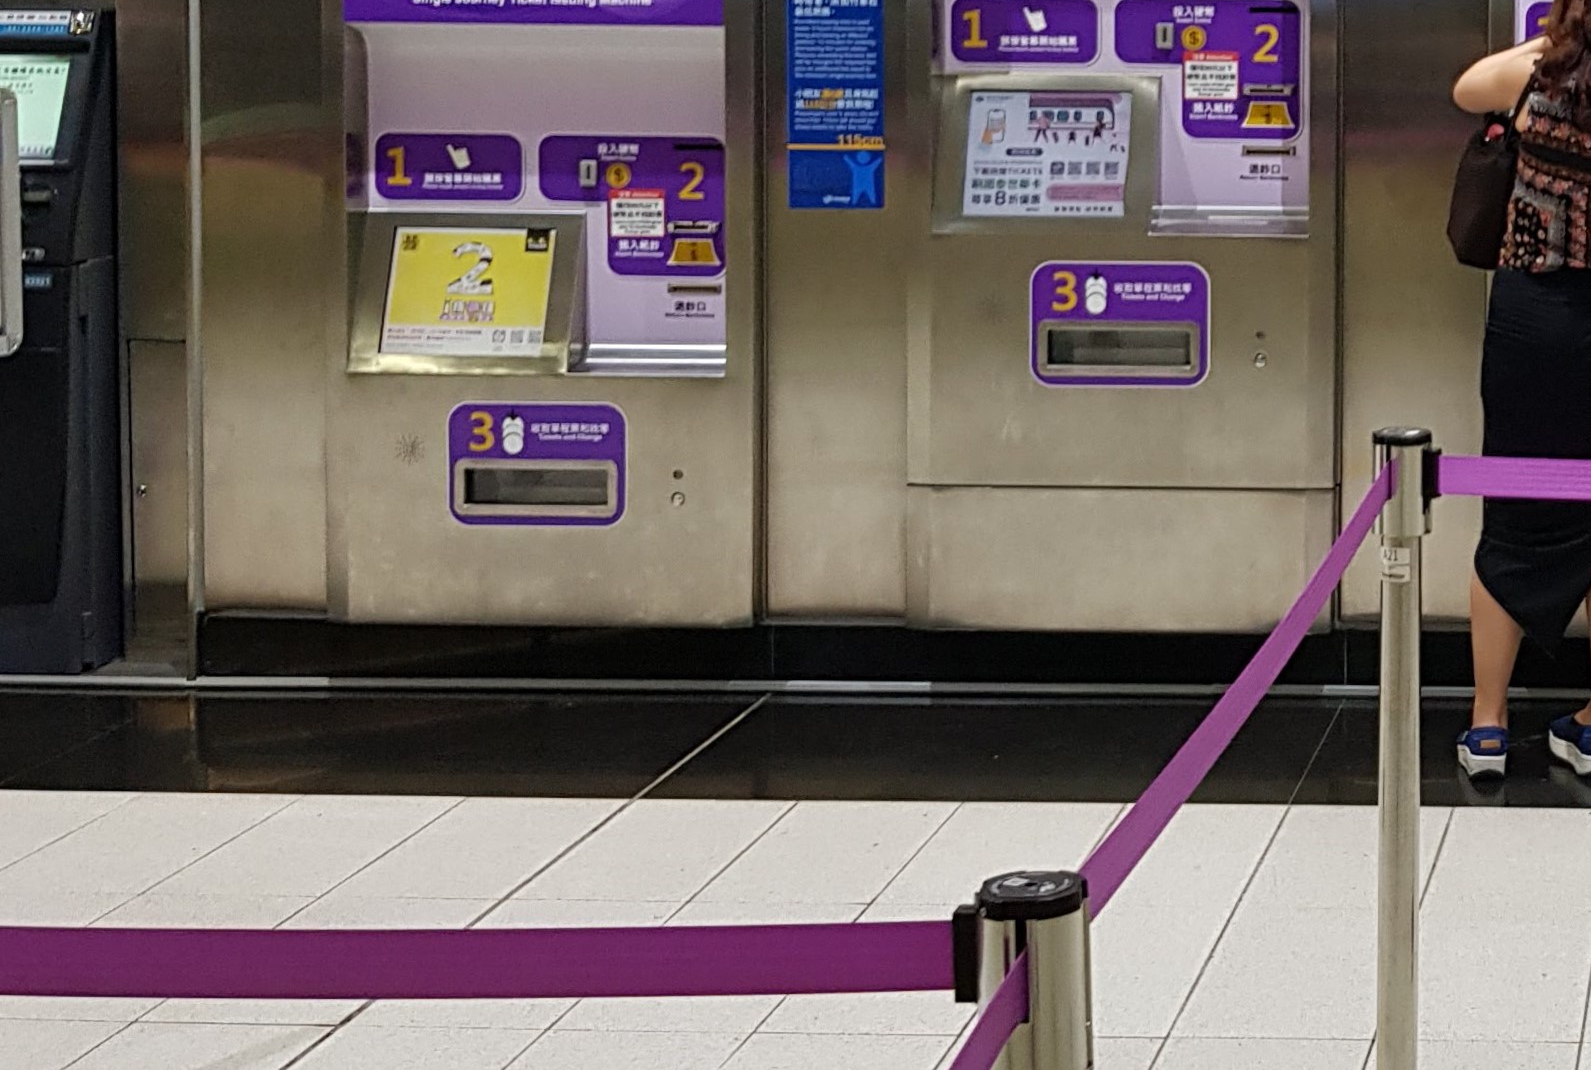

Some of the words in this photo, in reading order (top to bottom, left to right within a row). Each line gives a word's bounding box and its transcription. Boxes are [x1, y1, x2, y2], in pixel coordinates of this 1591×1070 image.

[963, 10, 987, 48] 1
[1253, 25, 1278, 62] 2
[387, 147, 412, 185] 1
[679, 163, 703, 199] 2
[1052, 271, 1077, 311] 3
[469, 412, 494, 451] 3
